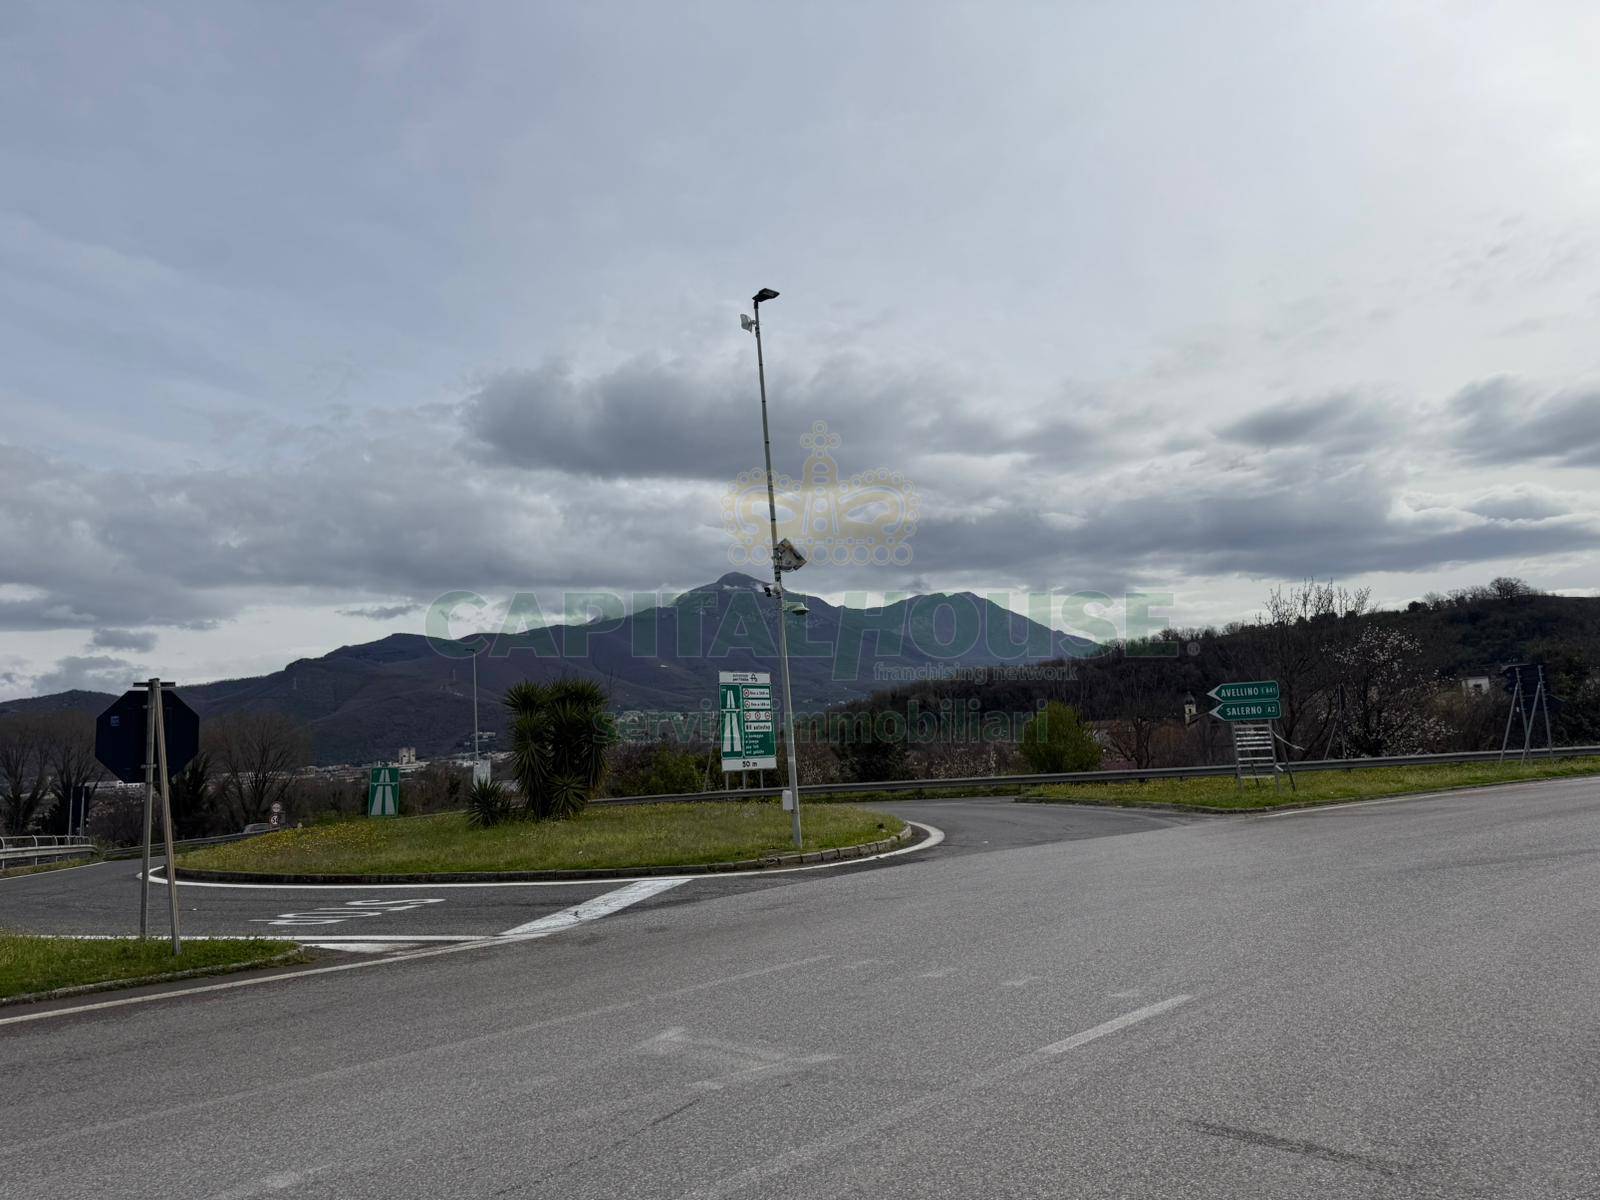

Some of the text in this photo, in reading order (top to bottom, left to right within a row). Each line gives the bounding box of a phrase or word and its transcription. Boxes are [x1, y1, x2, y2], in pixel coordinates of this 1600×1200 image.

[1221, 687, 1259, 697] AVELLINO
[1226, 706, 1262, 716] SALERNO
[742, 760, 750, 768] 50
